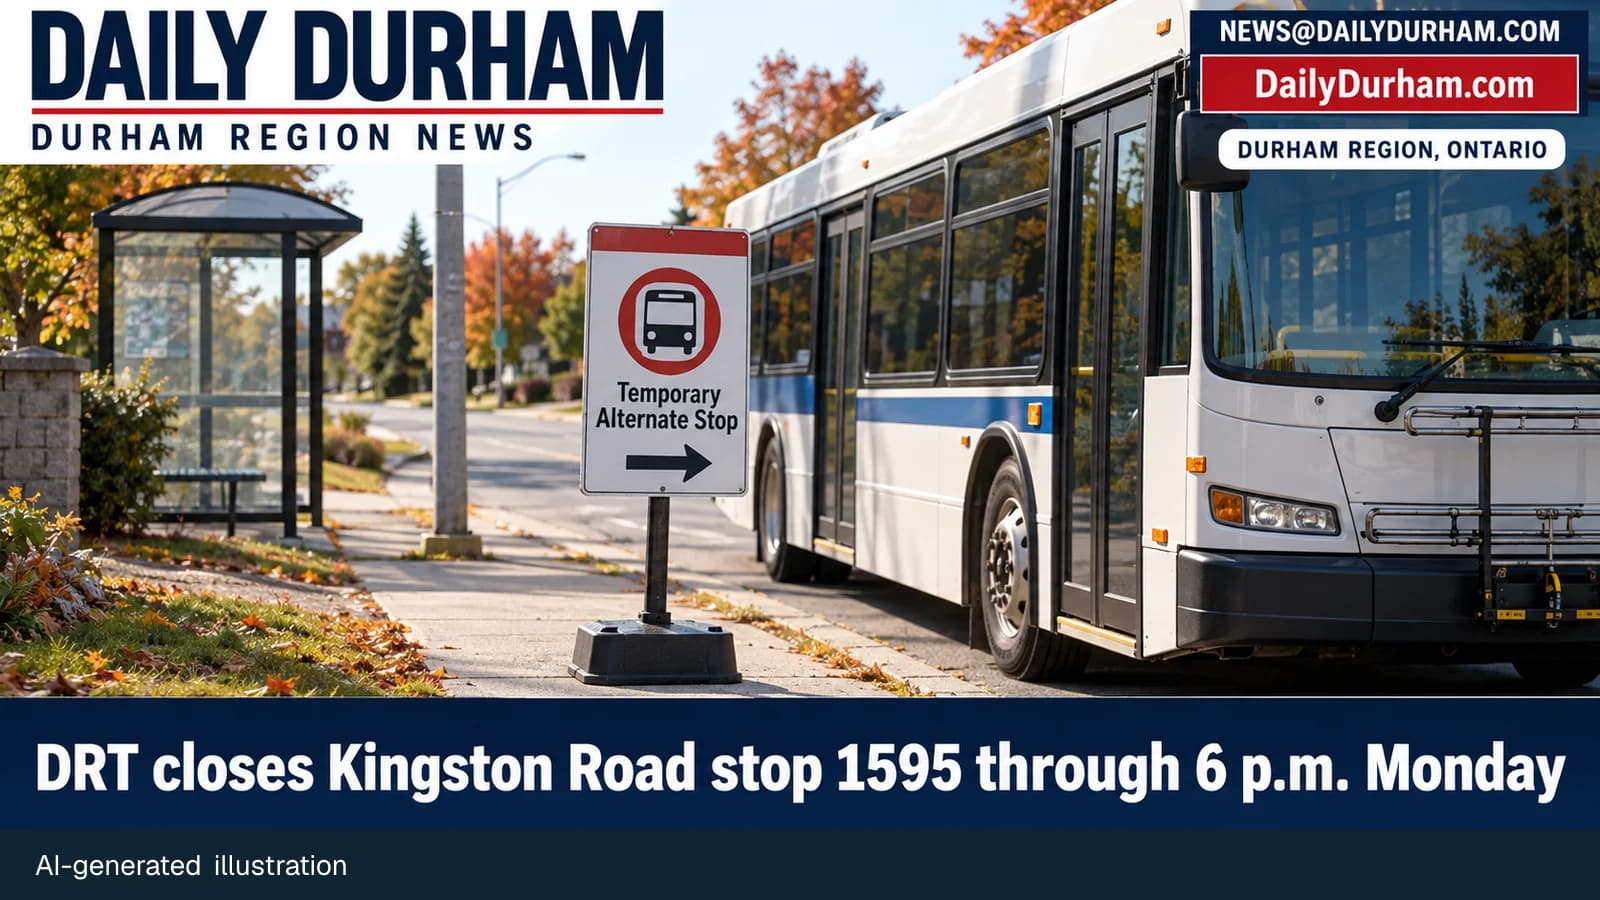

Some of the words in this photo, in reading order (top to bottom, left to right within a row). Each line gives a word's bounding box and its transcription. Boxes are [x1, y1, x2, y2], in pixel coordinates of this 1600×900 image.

[617, 381, 721, 408] Temporary
[595, 407, 689, 430] Alternate
[694, 408, 739, 435] Stop
